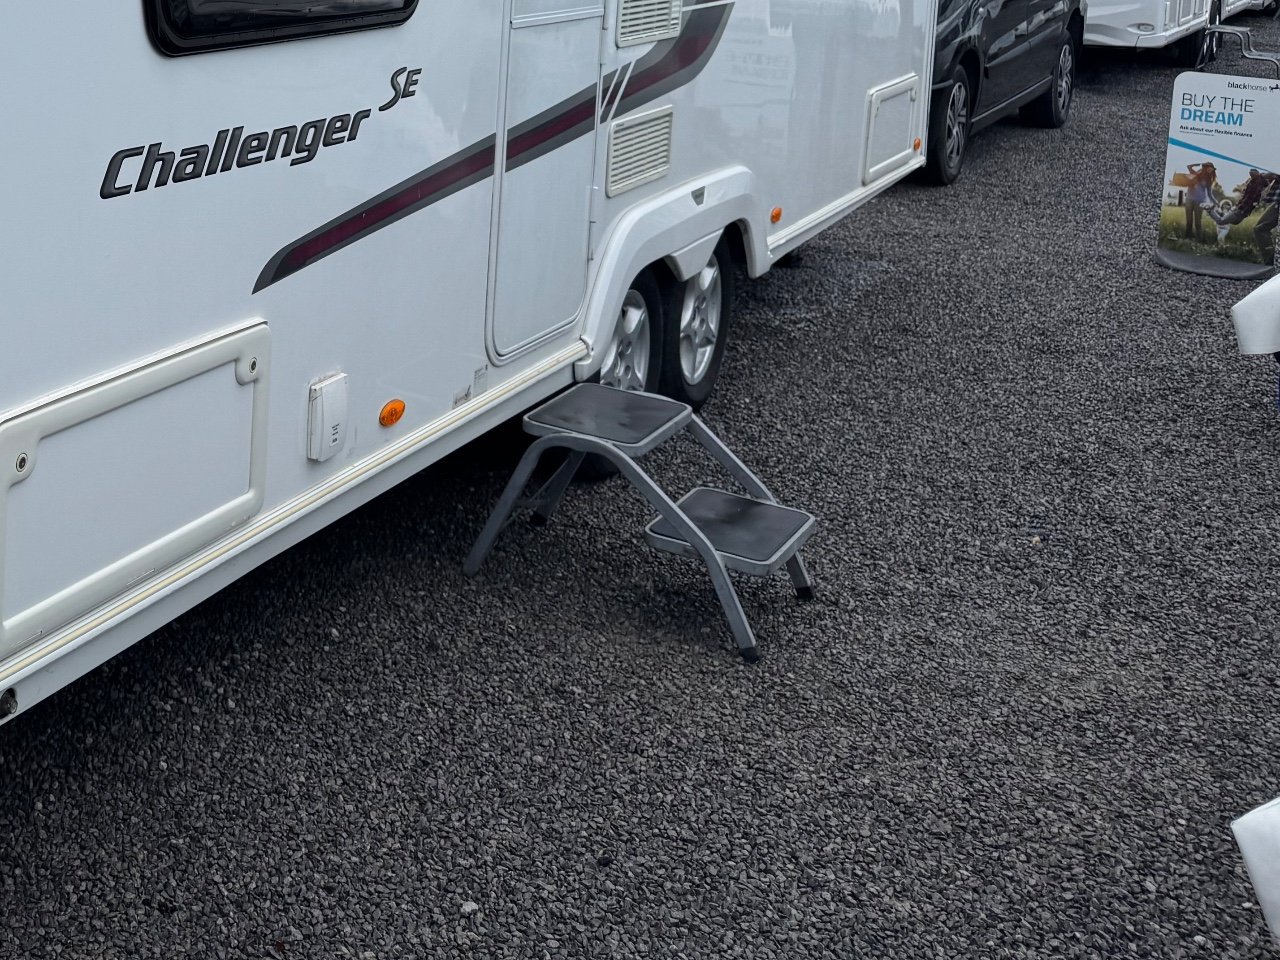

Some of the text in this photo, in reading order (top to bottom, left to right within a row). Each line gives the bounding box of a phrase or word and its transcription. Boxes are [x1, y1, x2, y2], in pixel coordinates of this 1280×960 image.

[1227, 81, 1268, 92] blackhorse
[1181, 92, 1256, 113] BUY THE
[1180, 107, 1244, 127] DREAM
[99, 66, 423, 200] Challenger SE
